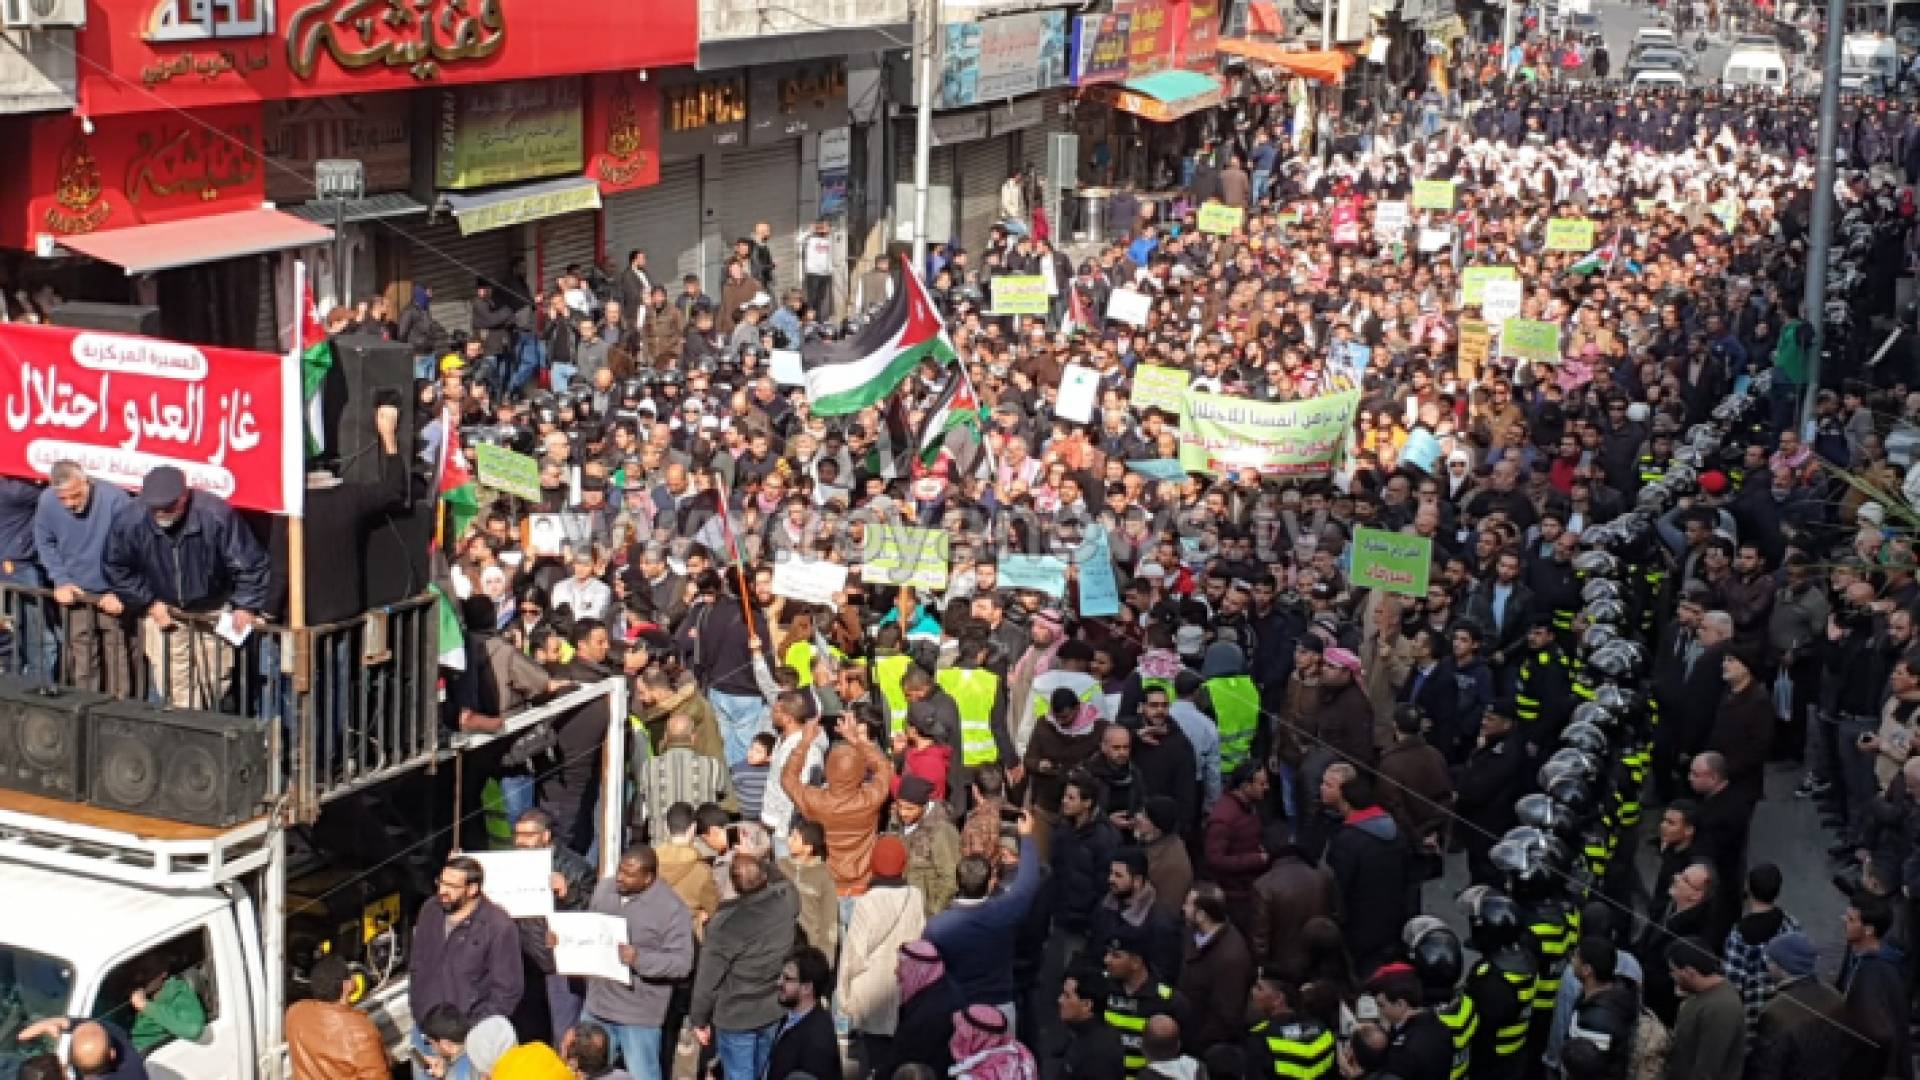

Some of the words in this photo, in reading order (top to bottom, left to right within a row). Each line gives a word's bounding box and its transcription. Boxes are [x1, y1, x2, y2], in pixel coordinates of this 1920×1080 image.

[5, 361, 110, 433] احتلال
[117, 381, 205, 451] العدو
[207, 387, 261, 467] غاز
